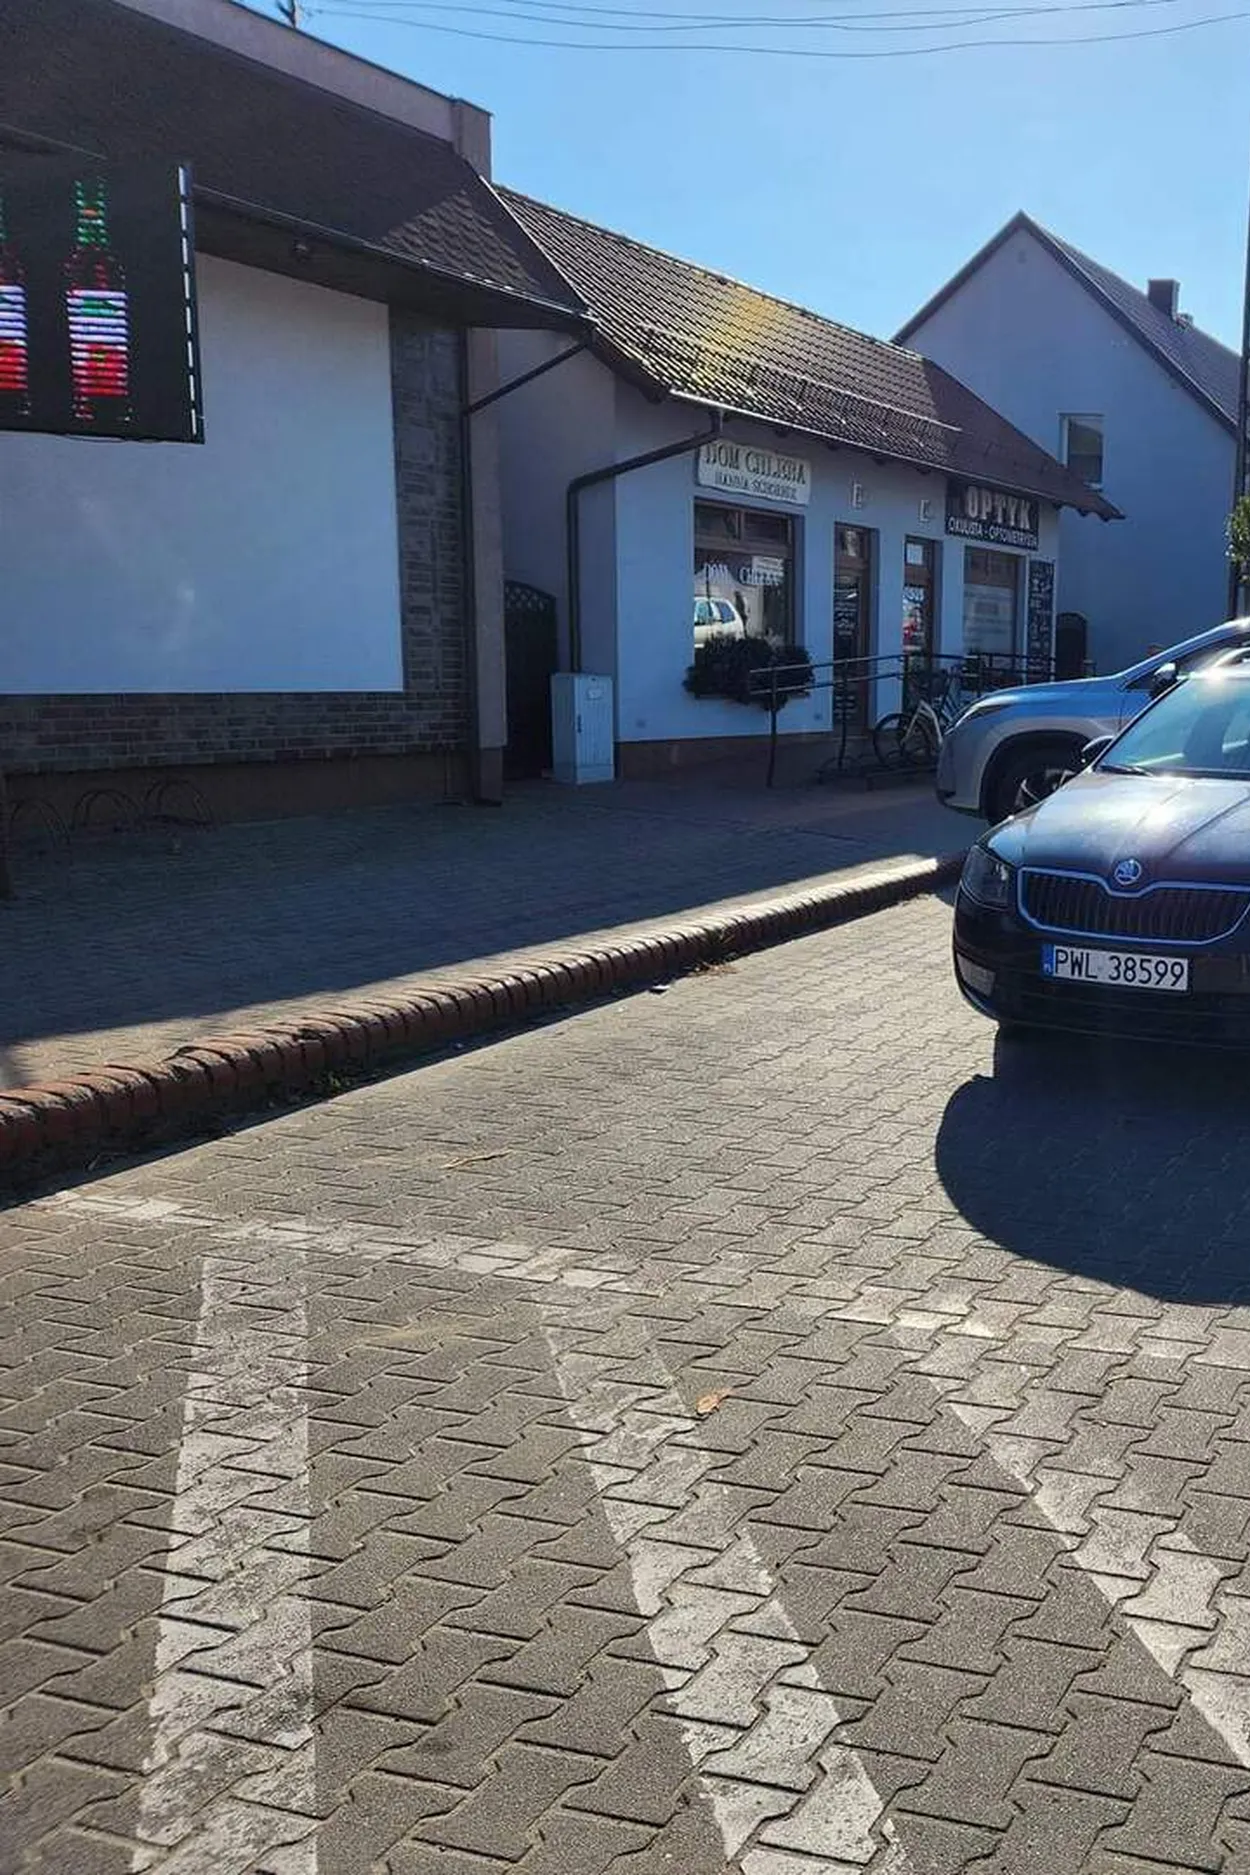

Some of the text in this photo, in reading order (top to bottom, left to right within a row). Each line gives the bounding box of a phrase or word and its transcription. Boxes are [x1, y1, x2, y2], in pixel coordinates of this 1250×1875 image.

[966, 486, 1030, 530] OPTYK
[1055, 949, 1184, 987] PWL 38599
